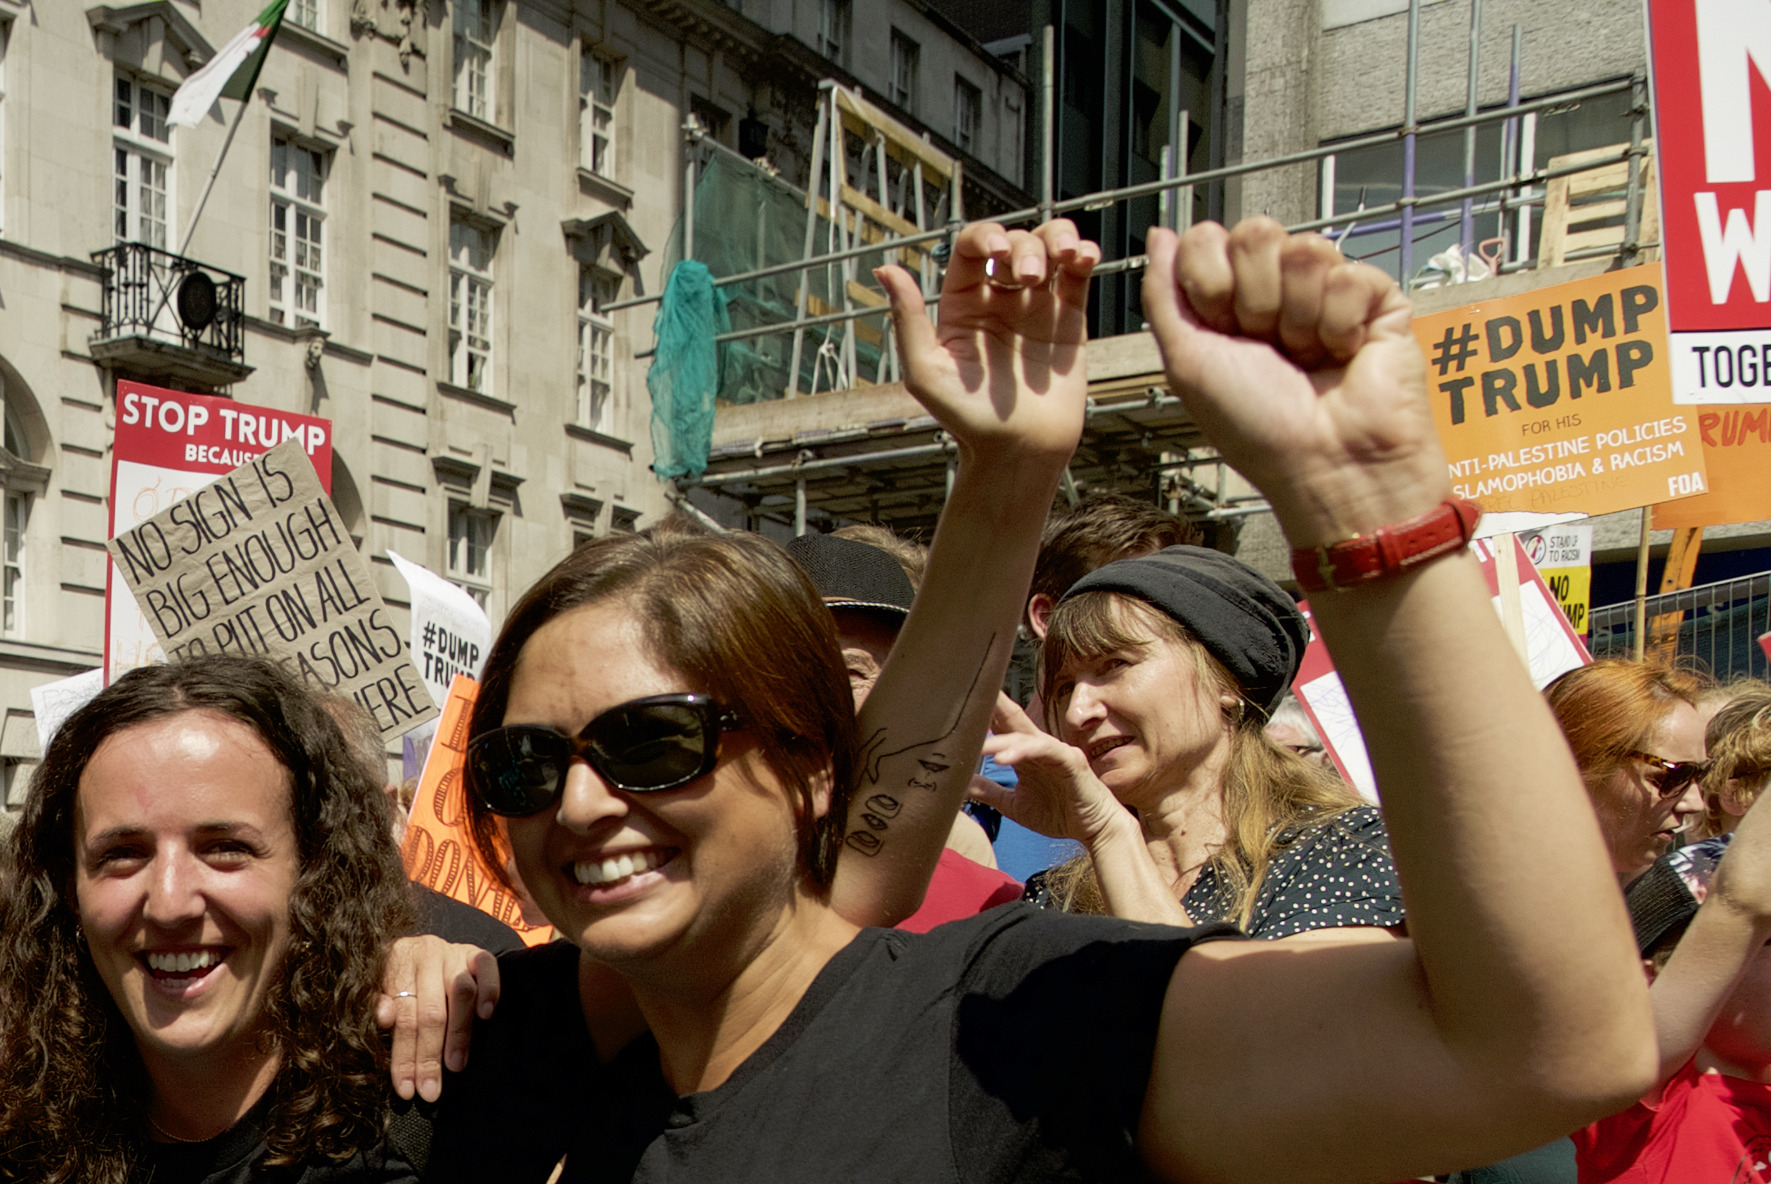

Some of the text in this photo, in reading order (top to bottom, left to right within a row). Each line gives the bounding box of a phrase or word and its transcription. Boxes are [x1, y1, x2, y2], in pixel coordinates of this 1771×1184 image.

[1431, 285, 1659, 376] #DUMP
[1438, 340, 1654, 426] TRUMP
[122, 392, 326, 455] STOP TRUMP
[1447, 416, 1688, 480] NTI-PALESTINE POLICIES
[1521, 413, 1582, 437] FOR HIS
[185, 444, 262, 467] BECAUS
[1452, 440, 1685, 501] SLAMOPHOBIA & RACISM
[1667, 471, 1705, 497] FOA
[115, 521, 173, 586] NO
[170, 477, 253, 555] SIGN
[253, 453, 294, 509] IS
[146, 573, 211, 640] BIG
[206, 498, 342, 606] ENOUGH
[1549, 550, 1559, 562] TO
[265, 583, 317, 643] ON
[314, 559, 371, 624] ALL
[1549, 575, 1570, 602] NO
[279, 608, 402, 692] EASONS
[422, 620, 479, 670] #DUMP
[423, 650, 475, 689] TRU
